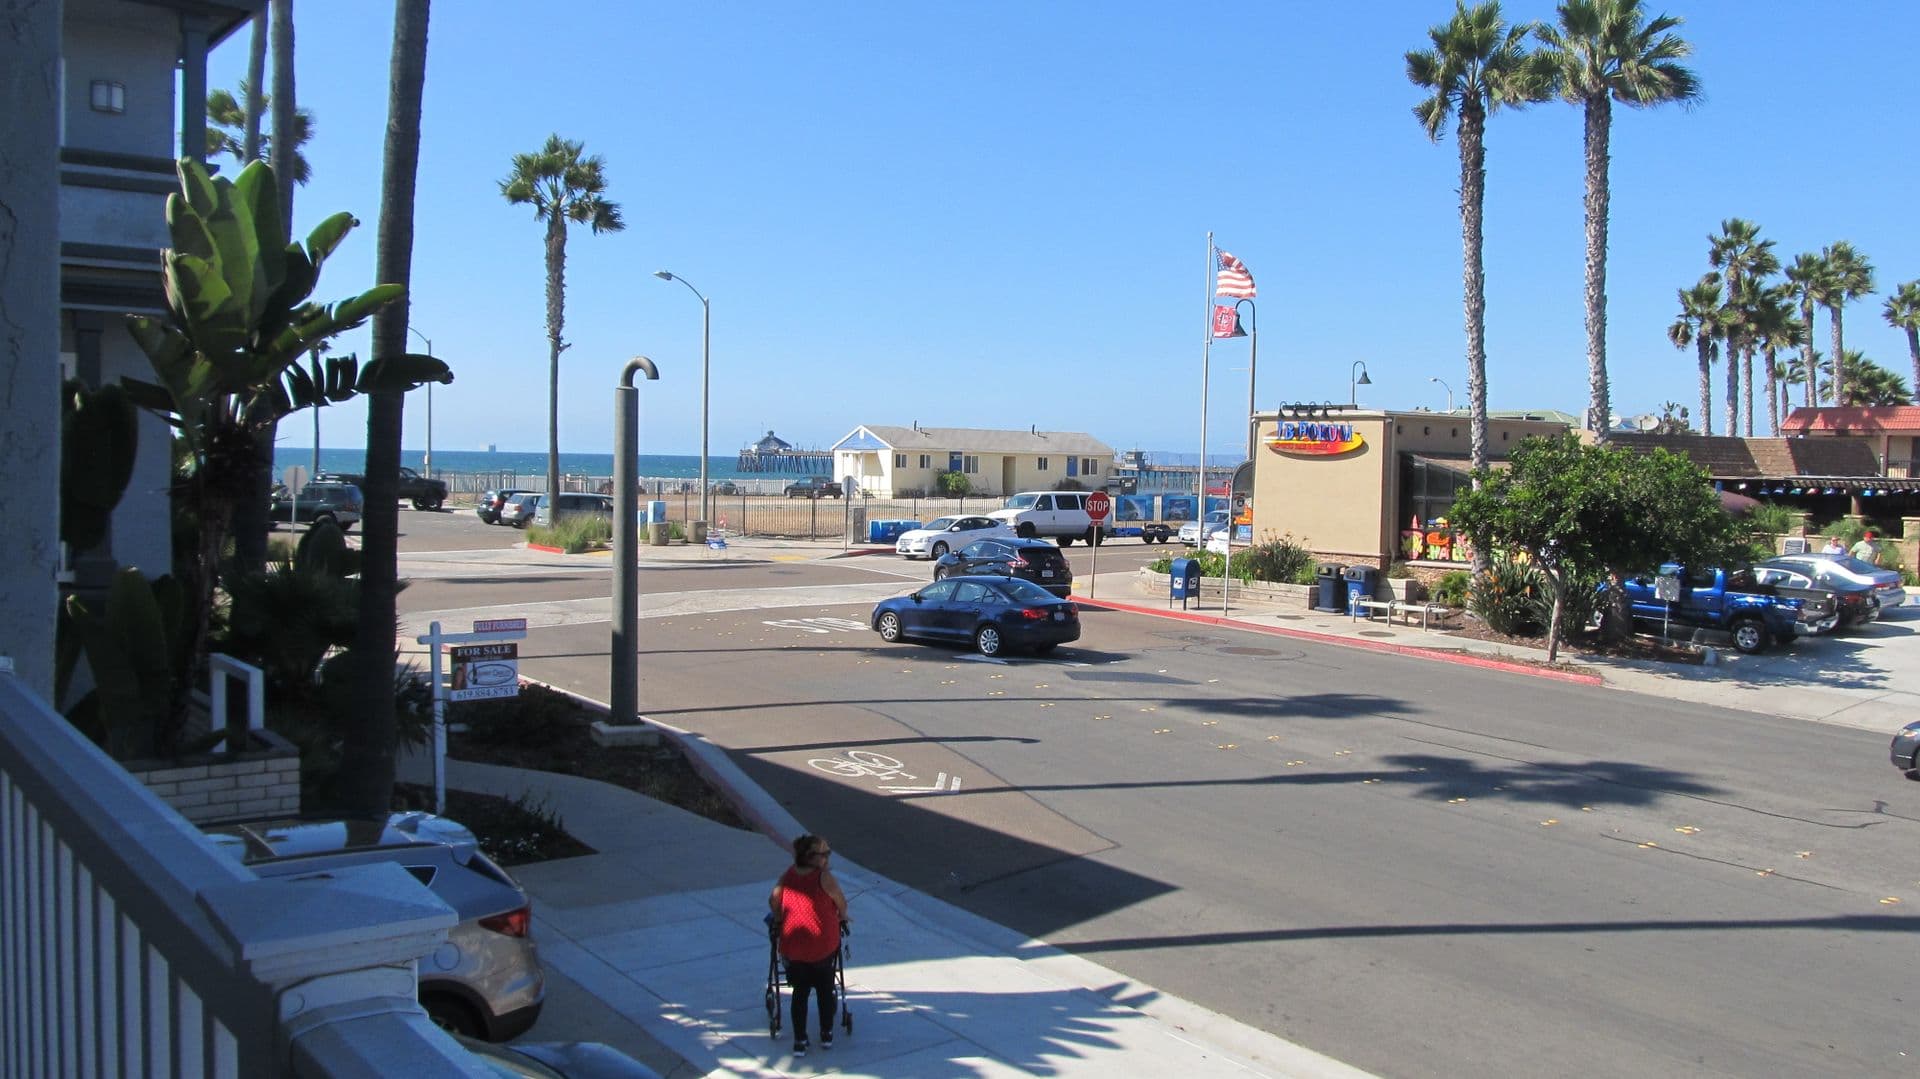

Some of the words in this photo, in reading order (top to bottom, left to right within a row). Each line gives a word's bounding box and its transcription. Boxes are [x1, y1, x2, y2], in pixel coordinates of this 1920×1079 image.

[1277, 419, 1295, 440] IB
[1298, 420, 1353, 442] FORUM
[1087, 500, 1109, 512] STOP
[457, 647, 481, 656] FOR
[483, 645, 512, 654] SALE
